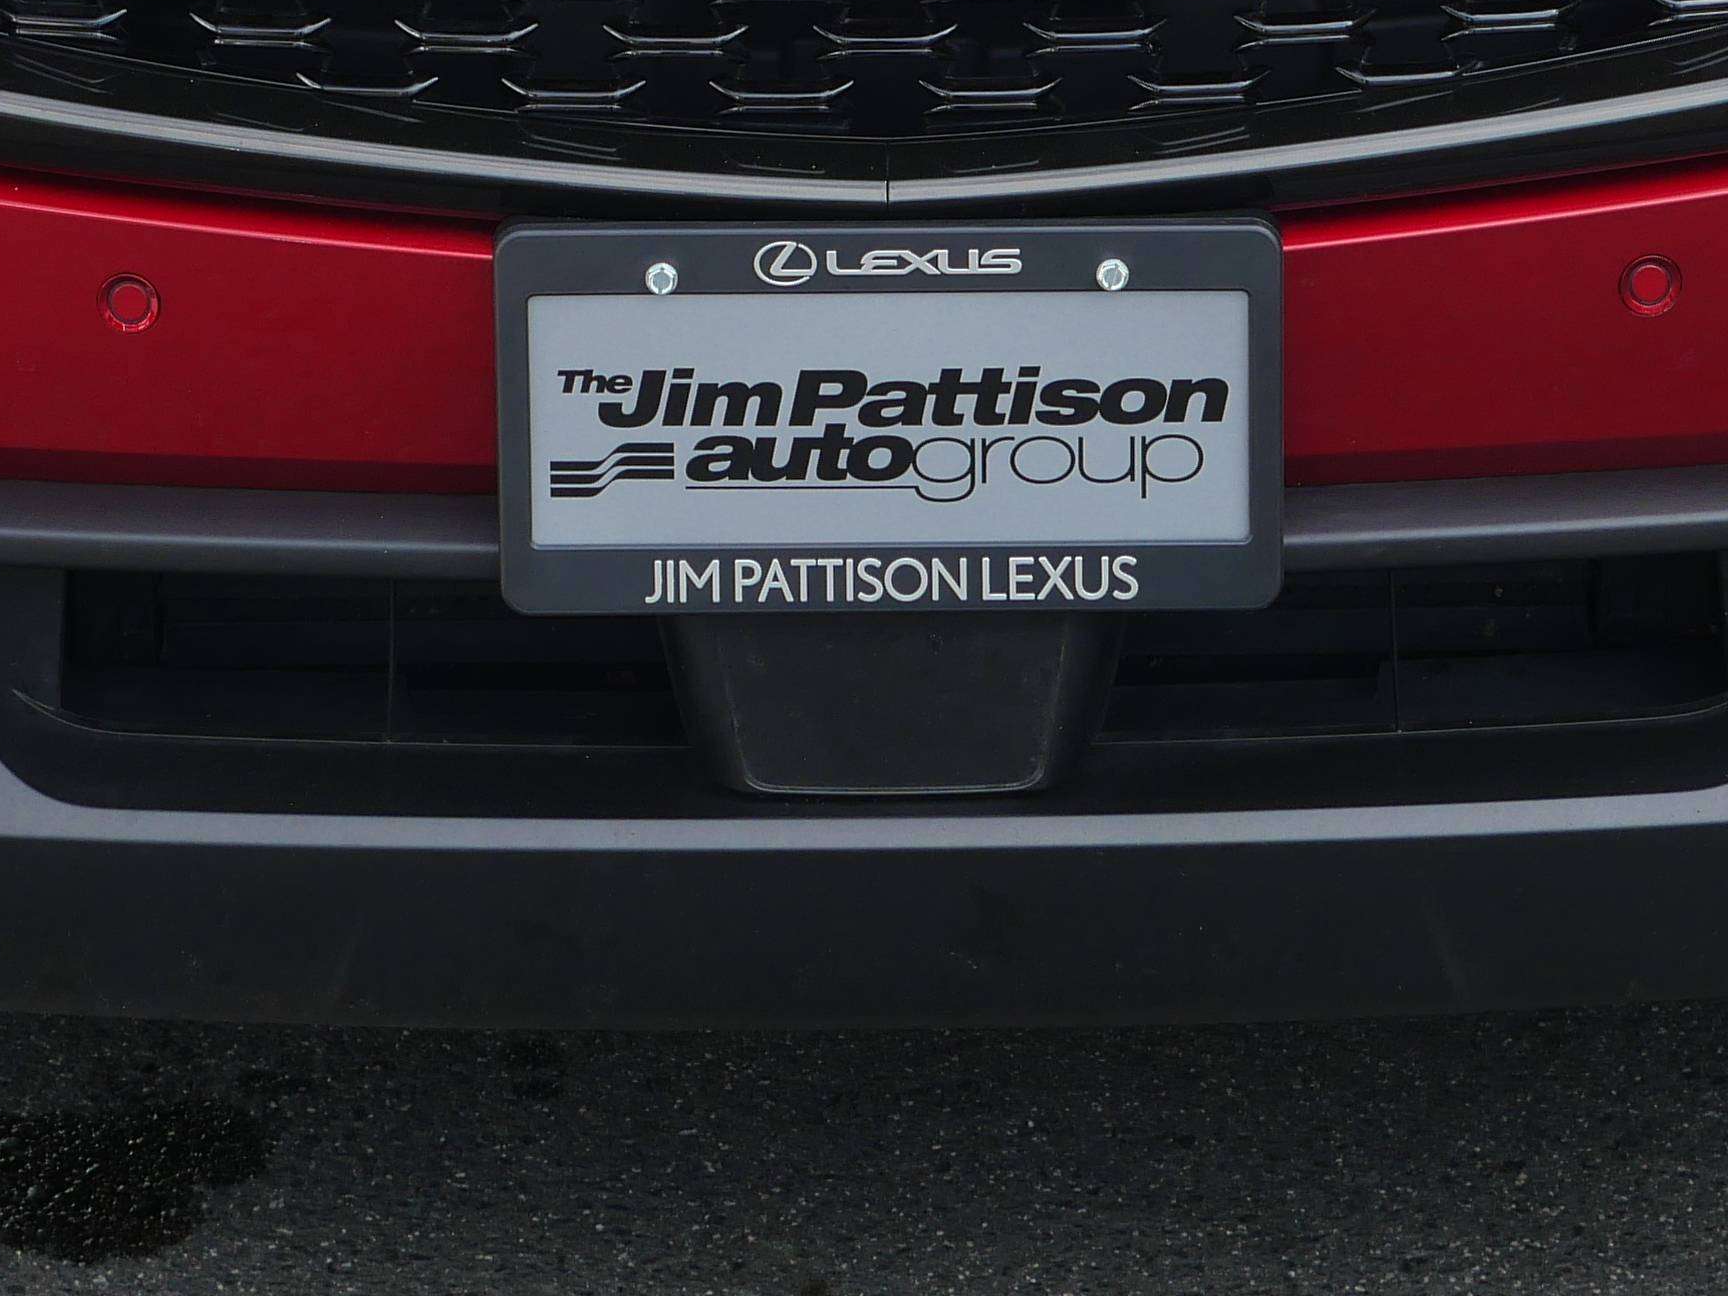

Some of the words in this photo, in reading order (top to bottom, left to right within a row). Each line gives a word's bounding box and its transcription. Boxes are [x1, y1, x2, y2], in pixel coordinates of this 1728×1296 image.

[826, 248, 1022, 276] LEXUS
[557, 369, 634, 395] The
[598, 367, 784, 429] Jim
[788, 365, 1230, 428] Pattison
[645, 559, 720, 603] JIM
[734, 557, 968, 602] PATTISON
[981, 555, 1140, 601] LEXUS
